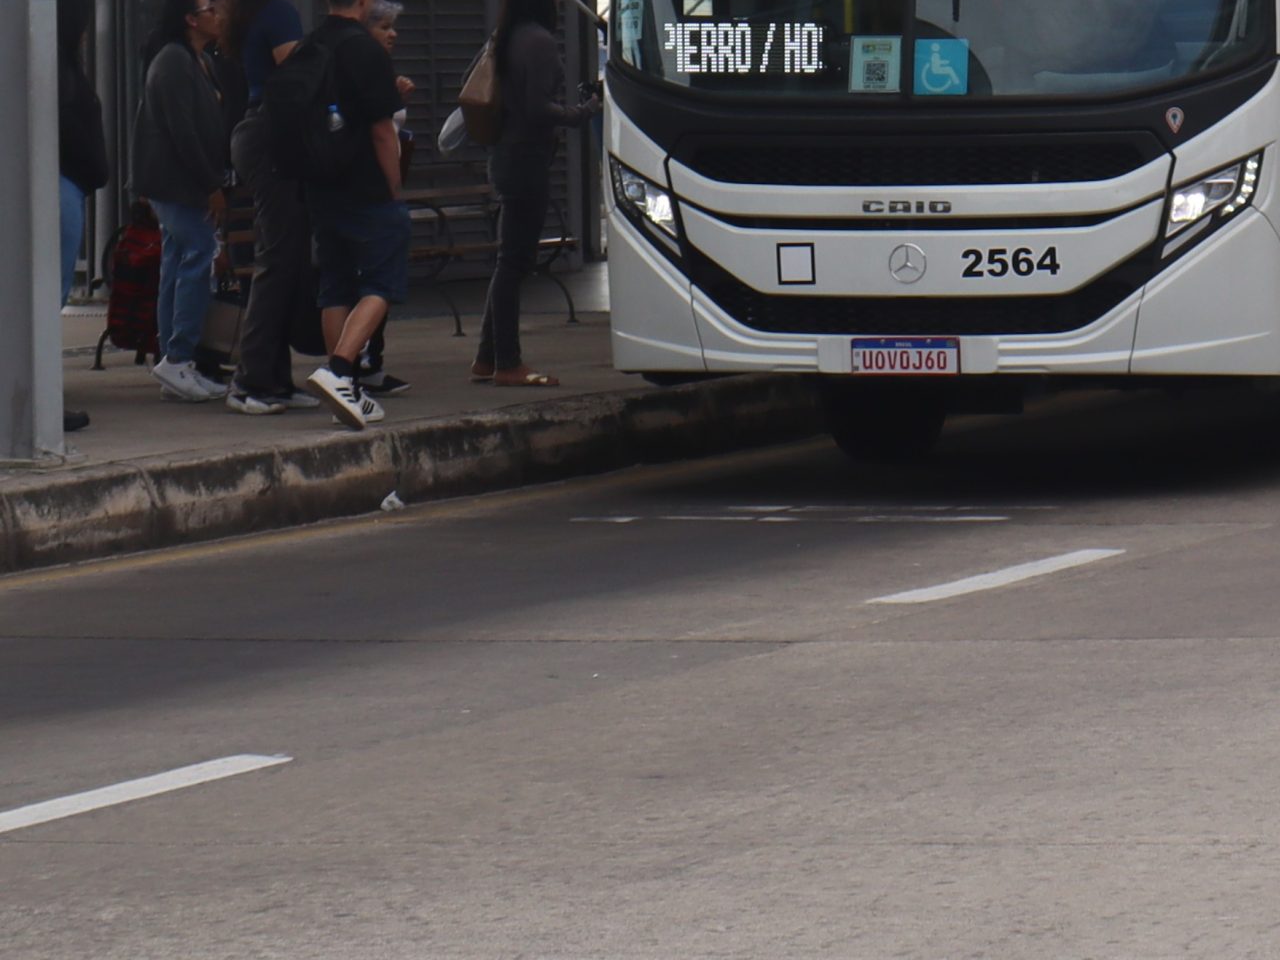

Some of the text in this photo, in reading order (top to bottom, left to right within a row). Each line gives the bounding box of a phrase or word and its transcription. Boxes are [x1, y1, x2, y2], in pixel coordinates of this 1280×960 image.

[760, 23, 776, 72] /
[862, 201, 952, 213] CAIO
[961, 246, 1060, 278] 2564
